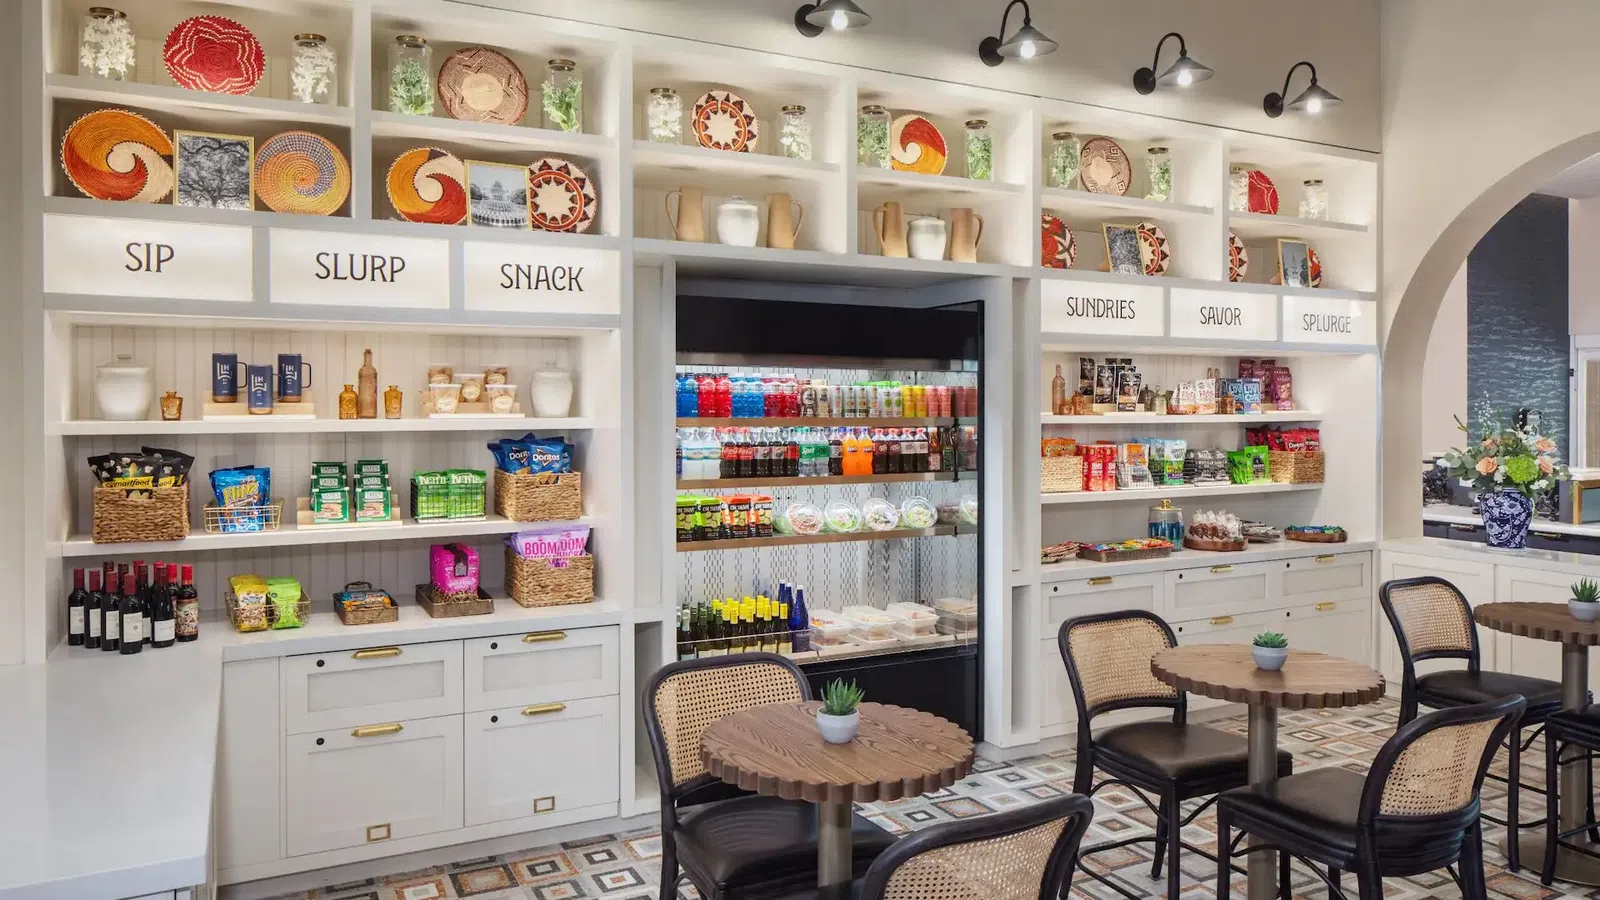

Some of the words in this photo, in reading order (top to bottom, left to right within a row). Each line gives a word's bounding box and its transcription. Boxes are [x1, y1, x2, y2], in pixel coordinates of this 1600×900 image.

[124, 242, 175, 273] SIP
[314, 252, 406, 283] SLURP
[500, 263, 584, 292] SNACK
[1066, 296, 1136, 320] SUNDRIES
[1200, 306, 1242, 326] SAVOR
[1302, 313, 1352, 334] SPLURGE
[509, 450, 530, 460] Dorit
[524, 541, 558, 556] BOOM
[560, 537, 585, 551] OOM
